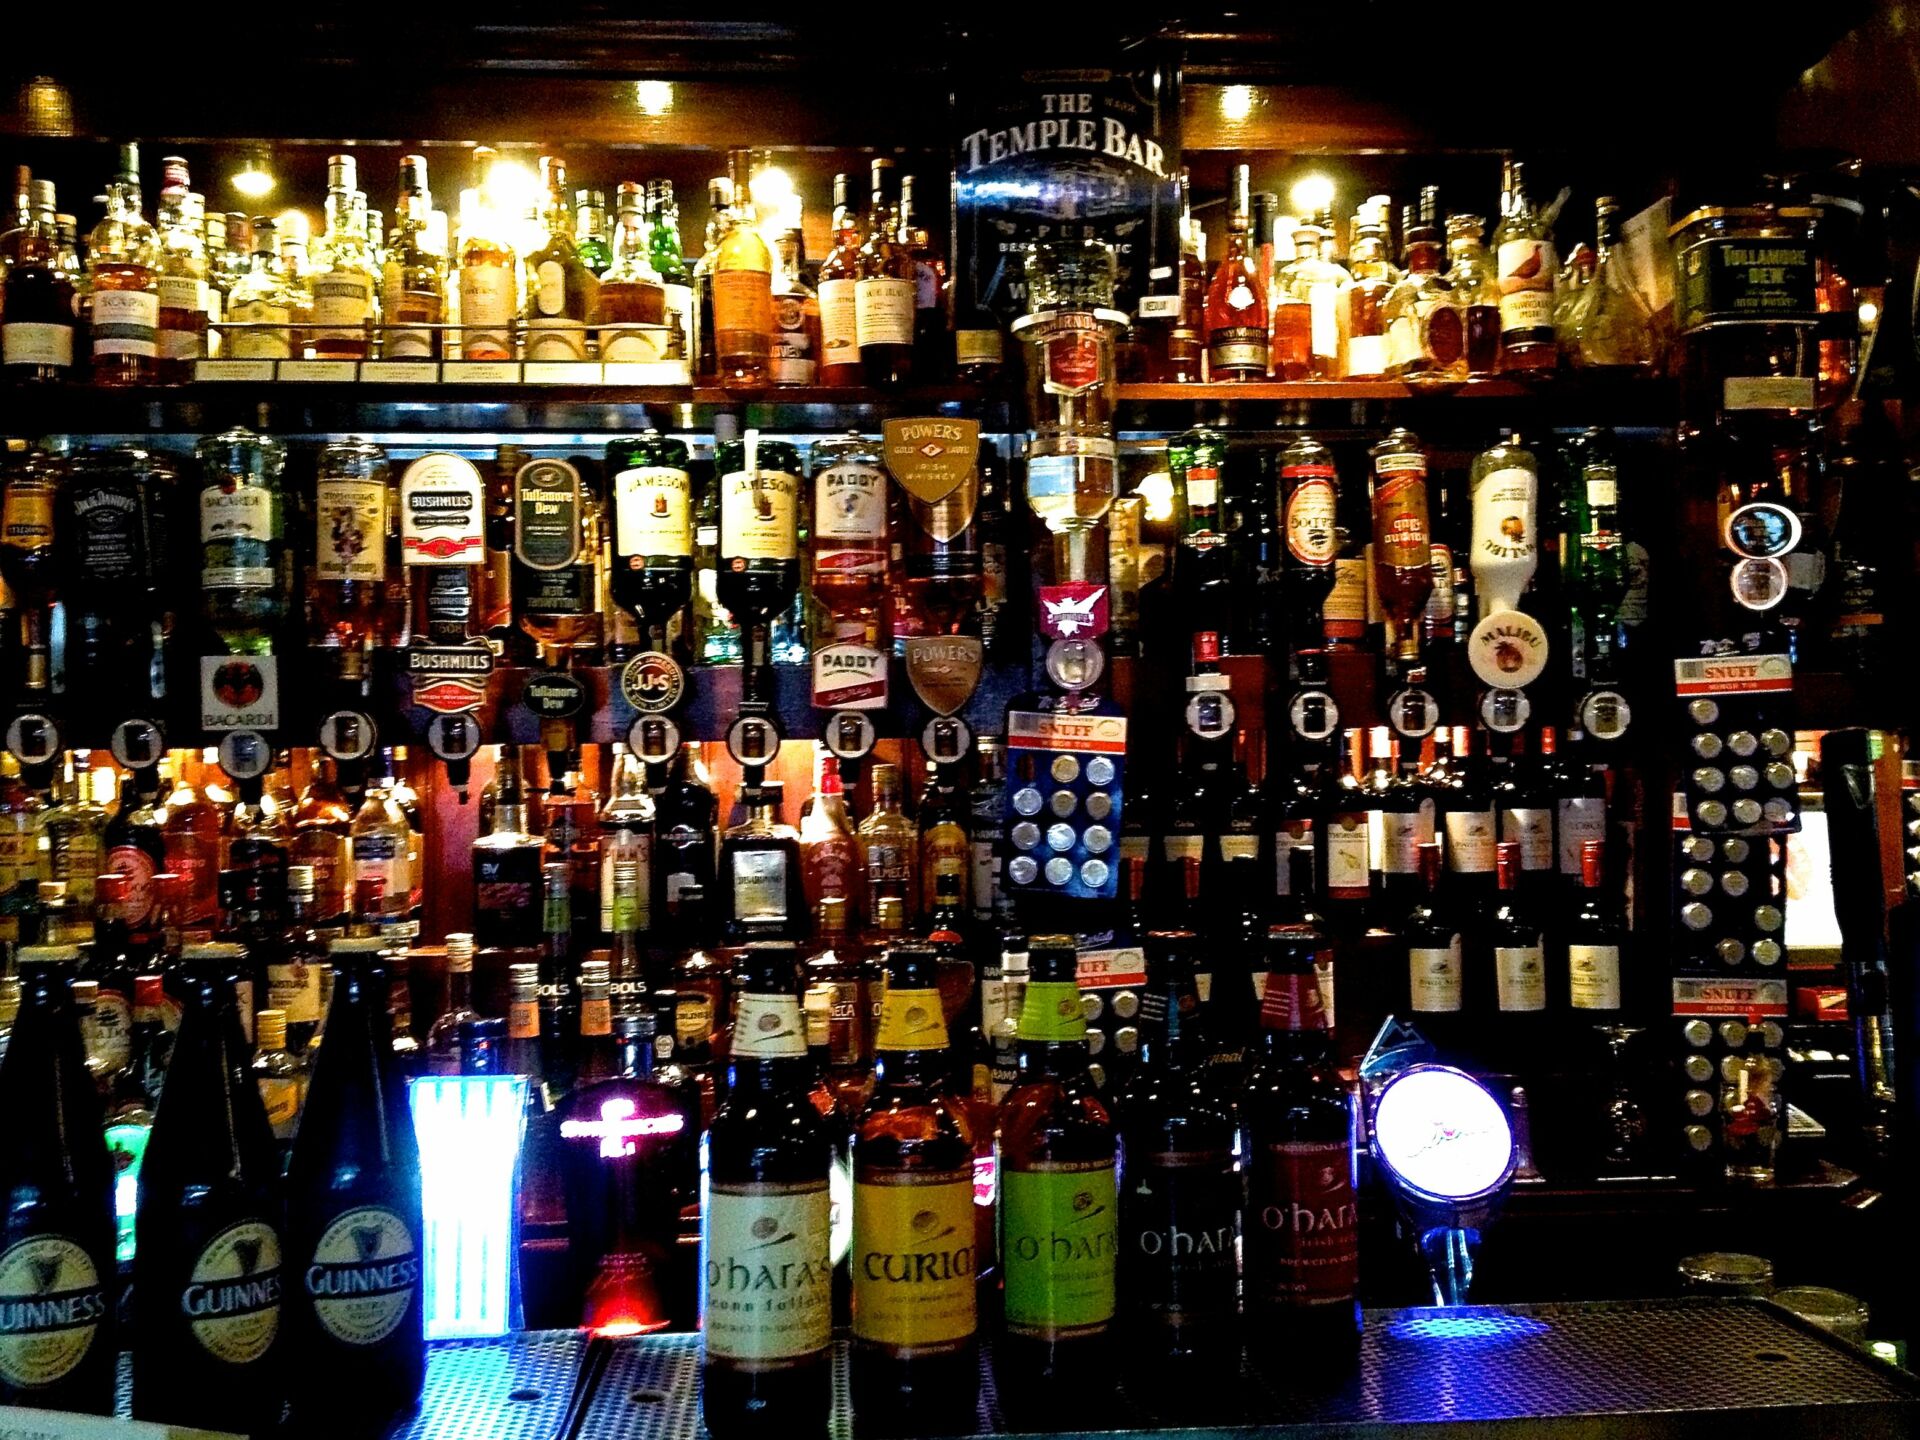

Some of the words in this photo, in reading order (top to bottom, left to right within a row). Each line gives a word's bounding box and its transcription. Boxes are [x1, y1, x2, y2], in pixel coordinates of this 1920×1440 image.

[1041, 93, 1093, 114] THE
[961, 118, 1098, 175] TEMPLE
[1101, 117, 1168, 181] BAR
[901, 424, 963, 442] POWERS
[735, 478, 794, 494] JAMESON
[827, 474, 879, 488] PADDY
[411, 495, 472, 508] BUSHMILLS
[520, 488, 575, 503] Tullamore
[534, 503, 560, 515] Dew
[1286, 517, 1336, 530] EADOG
[1480, 625, 1542, 649] MALIBU
[409, 653, 491, 670] BUSHMILLS
[823, 653, 879, 668] PADDY
[912, 644, 978, 665] POWERS
[1704, 666, 1758, 679] SNUFF
[529, 684, 579, 698] Tullamore
[542, 697, 564, 710] Dew
[1037, 723, 1094, 738] SNUFF
[868, 866, 910, 879] OLMECA
[1080, 961, 1111, 973] UFF
[267, 981, 309, 989] GOSTURA
[535, 983, 570, 997] BOLS
[609, 981, 648, 995] BOLS
[1703, 988, 1758, 1001] SNUFF
[830, 1004, 855, 1017] MECA
[304, 1257, 419, 1295] GUINNESS
[180, 1274, 281, 1316] GUINNES
[0, 1291, 105, 1330] UINNESS
